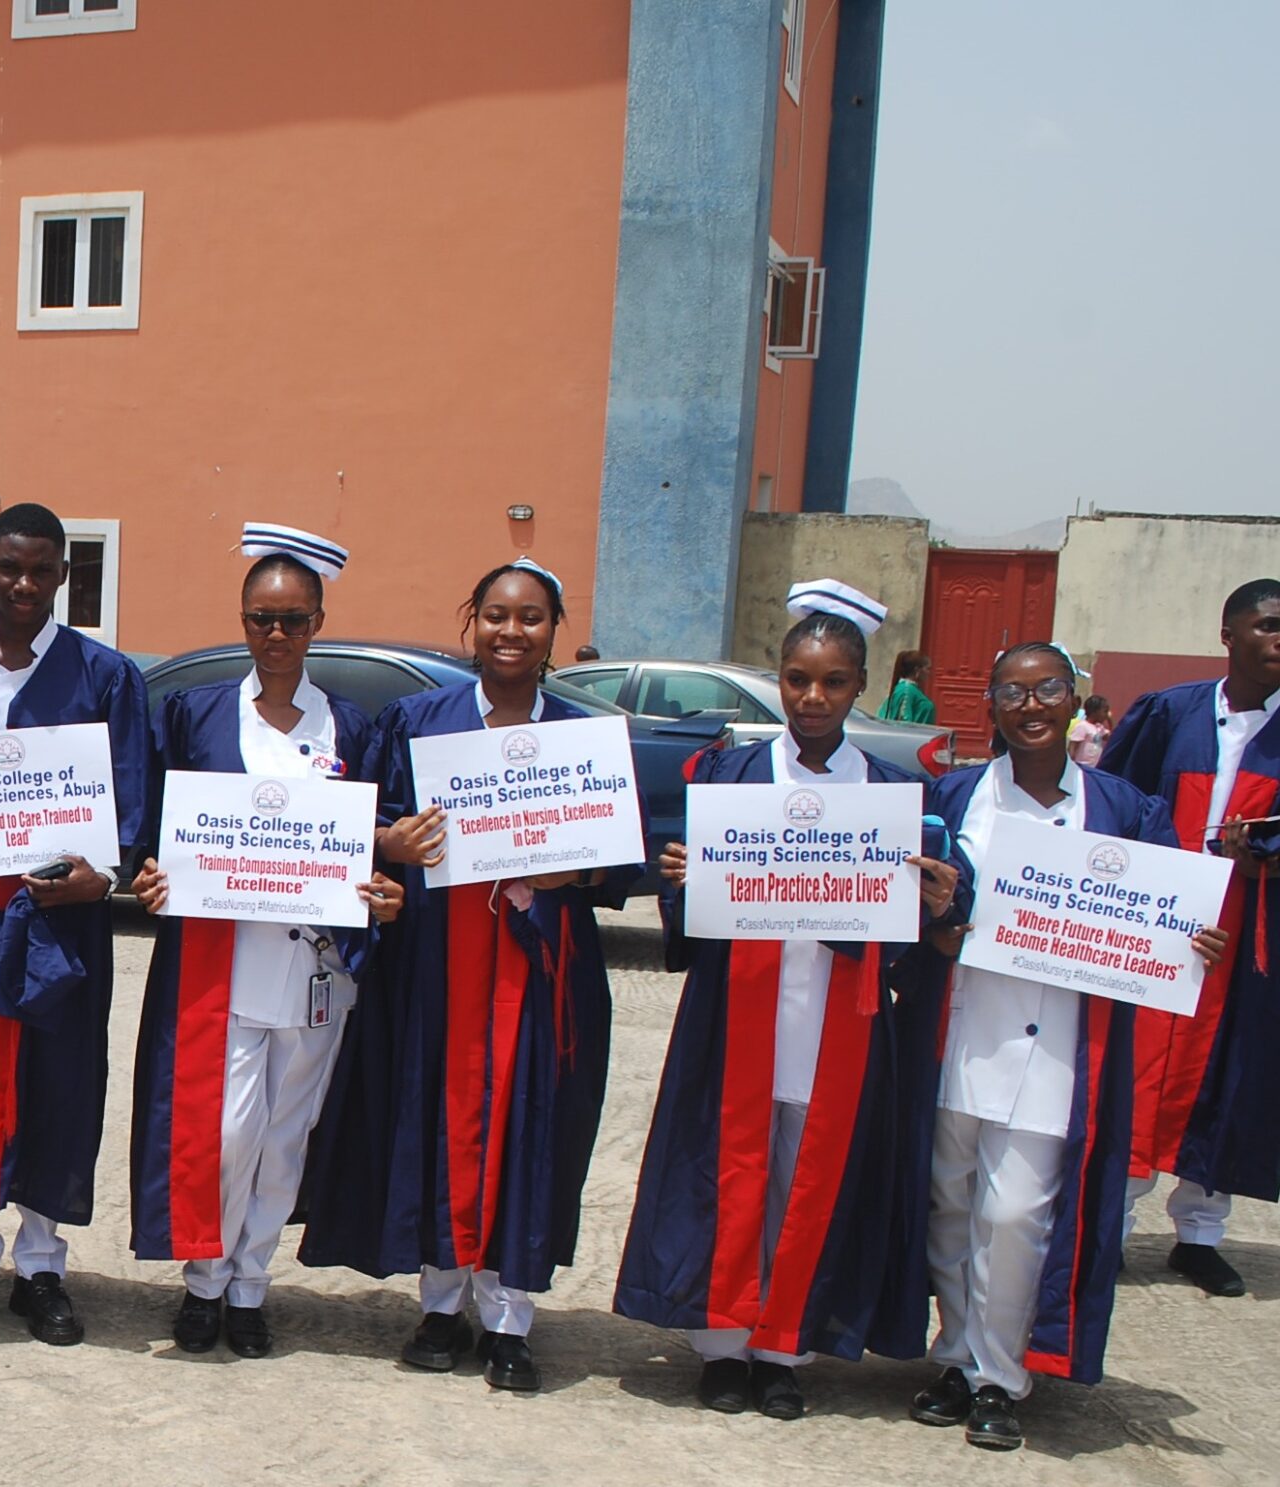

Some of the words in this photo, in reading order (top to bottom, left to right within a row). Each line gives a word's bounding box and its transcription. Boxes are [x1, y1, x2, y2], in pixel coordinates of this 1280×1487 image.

[59, 766, 73, 781] of
[450, 773, 498, 791] Oasis
[504, 766, 570, 783] College
[576, 760, 592, 775] of
[64, 781, 105, 798] Abuja
[498, 783, 576, 802] Sciences,
[582, 775, 627, 793] Abuja
[7, 814, 17, 828] to
[82, 807, 92, 822] to
[197, 813, 243, 829] Oasis
[250, 816, 313, 836] College
[319, 821, 336, 834] of
[512, 812, 522, 828] in
[523, 808, 562, 826] Nursing,
[563, 802, 613, 821] Excellence
[175, 829, 234, 849] Nursing
[240, 832, 315, 853] Sciences,
[321, 837, 364, 857] Abuja
[513, 831, 523, 847] in
[725, 829, 776, 844] Oasis
[783, 829, 853, 847] College
[860, 828, 878, 843] of
[472, 857, 528, 872] #OasisNursing
[529, 847, 598, 864] #MatriculationDay
[703, 847, 767, 866] Nursing
[774, 847, 856, 865] Sciences,
[863, 847, 911, 866] Abuja
[1022, 866, 1073, 889] Oasis
[1080, 878, 1151, 906] College
[1157, 895, 1178, 910] of
[202, 897, 256, 914] #OasisNursing
[257, 900, 323, 918] #MatriculationDay
[994, 878, 1060, 909] Nursing
[1066, 893, 1148, 927] Sciences,
[736, 917, 795, 932] #OasisNursing
[796, 918, 869, 933] #MatriculationDay
[1061, 919, 1103, 944] Future
[1105, 928, 1152, 954] Nurses
[995, 925, 1048, 952] Become
[1050, 937, 1122, 968] Healthcare
[1012, 955, 1072, 981] #OasisNursing
[1073, 969, 1148, 998] #MatriculationDay
